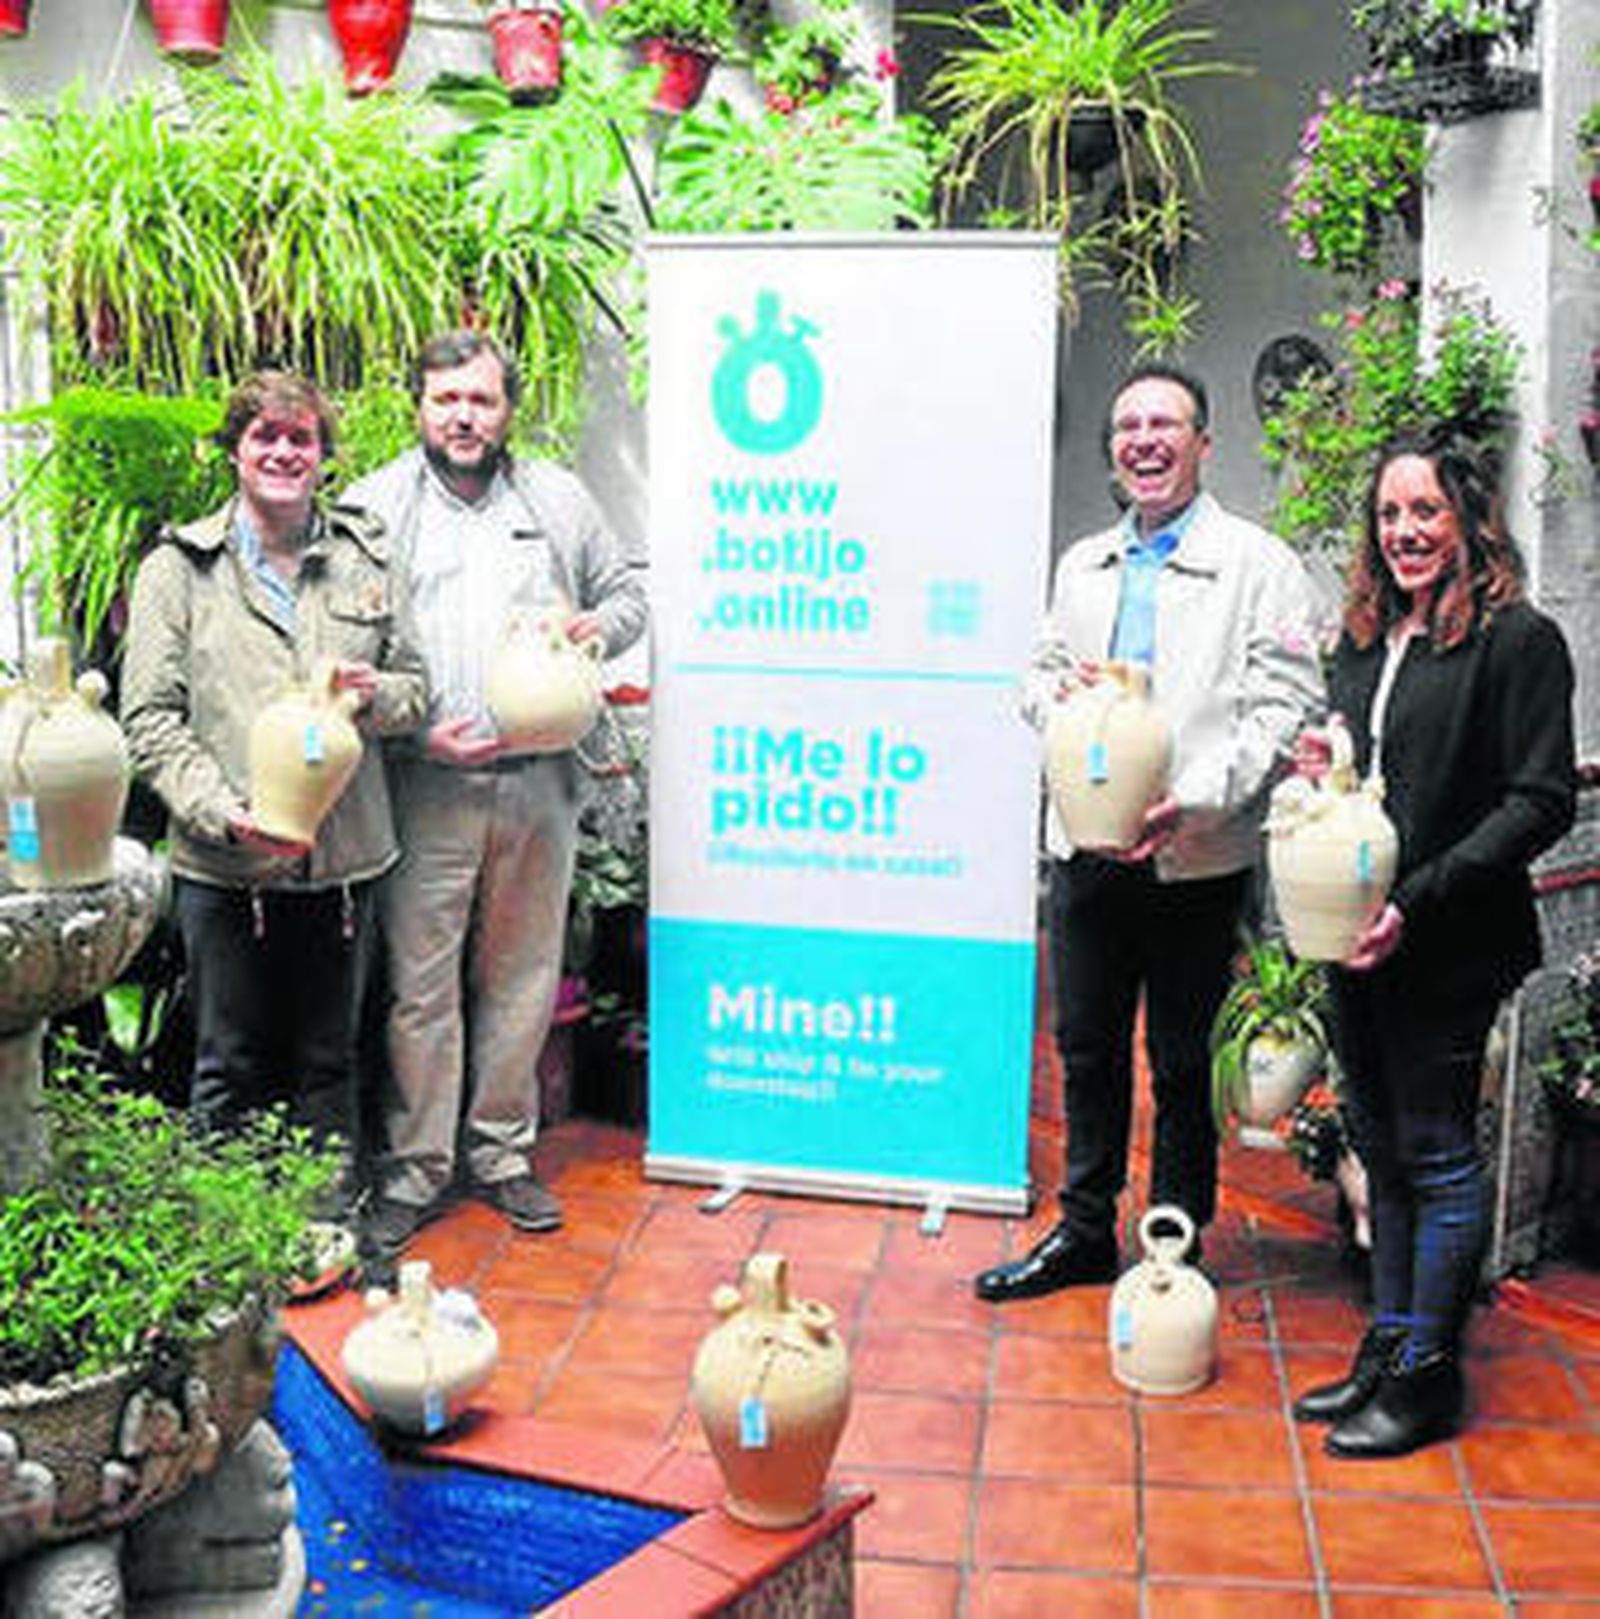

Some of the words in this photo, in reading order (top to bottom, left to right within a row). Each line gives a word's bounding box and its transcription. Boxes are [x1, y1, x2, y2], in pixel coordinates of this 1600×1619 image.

[710, 479, 838, 515] www
[702, 528, 868, 580] .botijo
[700, 583, 870, 632] .online
[712, 724, 844, 779] ¡¡Me
[868, 726, 927, 782] lo
[711, 783, 897, 837] pido!!
[708, 983, 896, 1042] Mine!!
